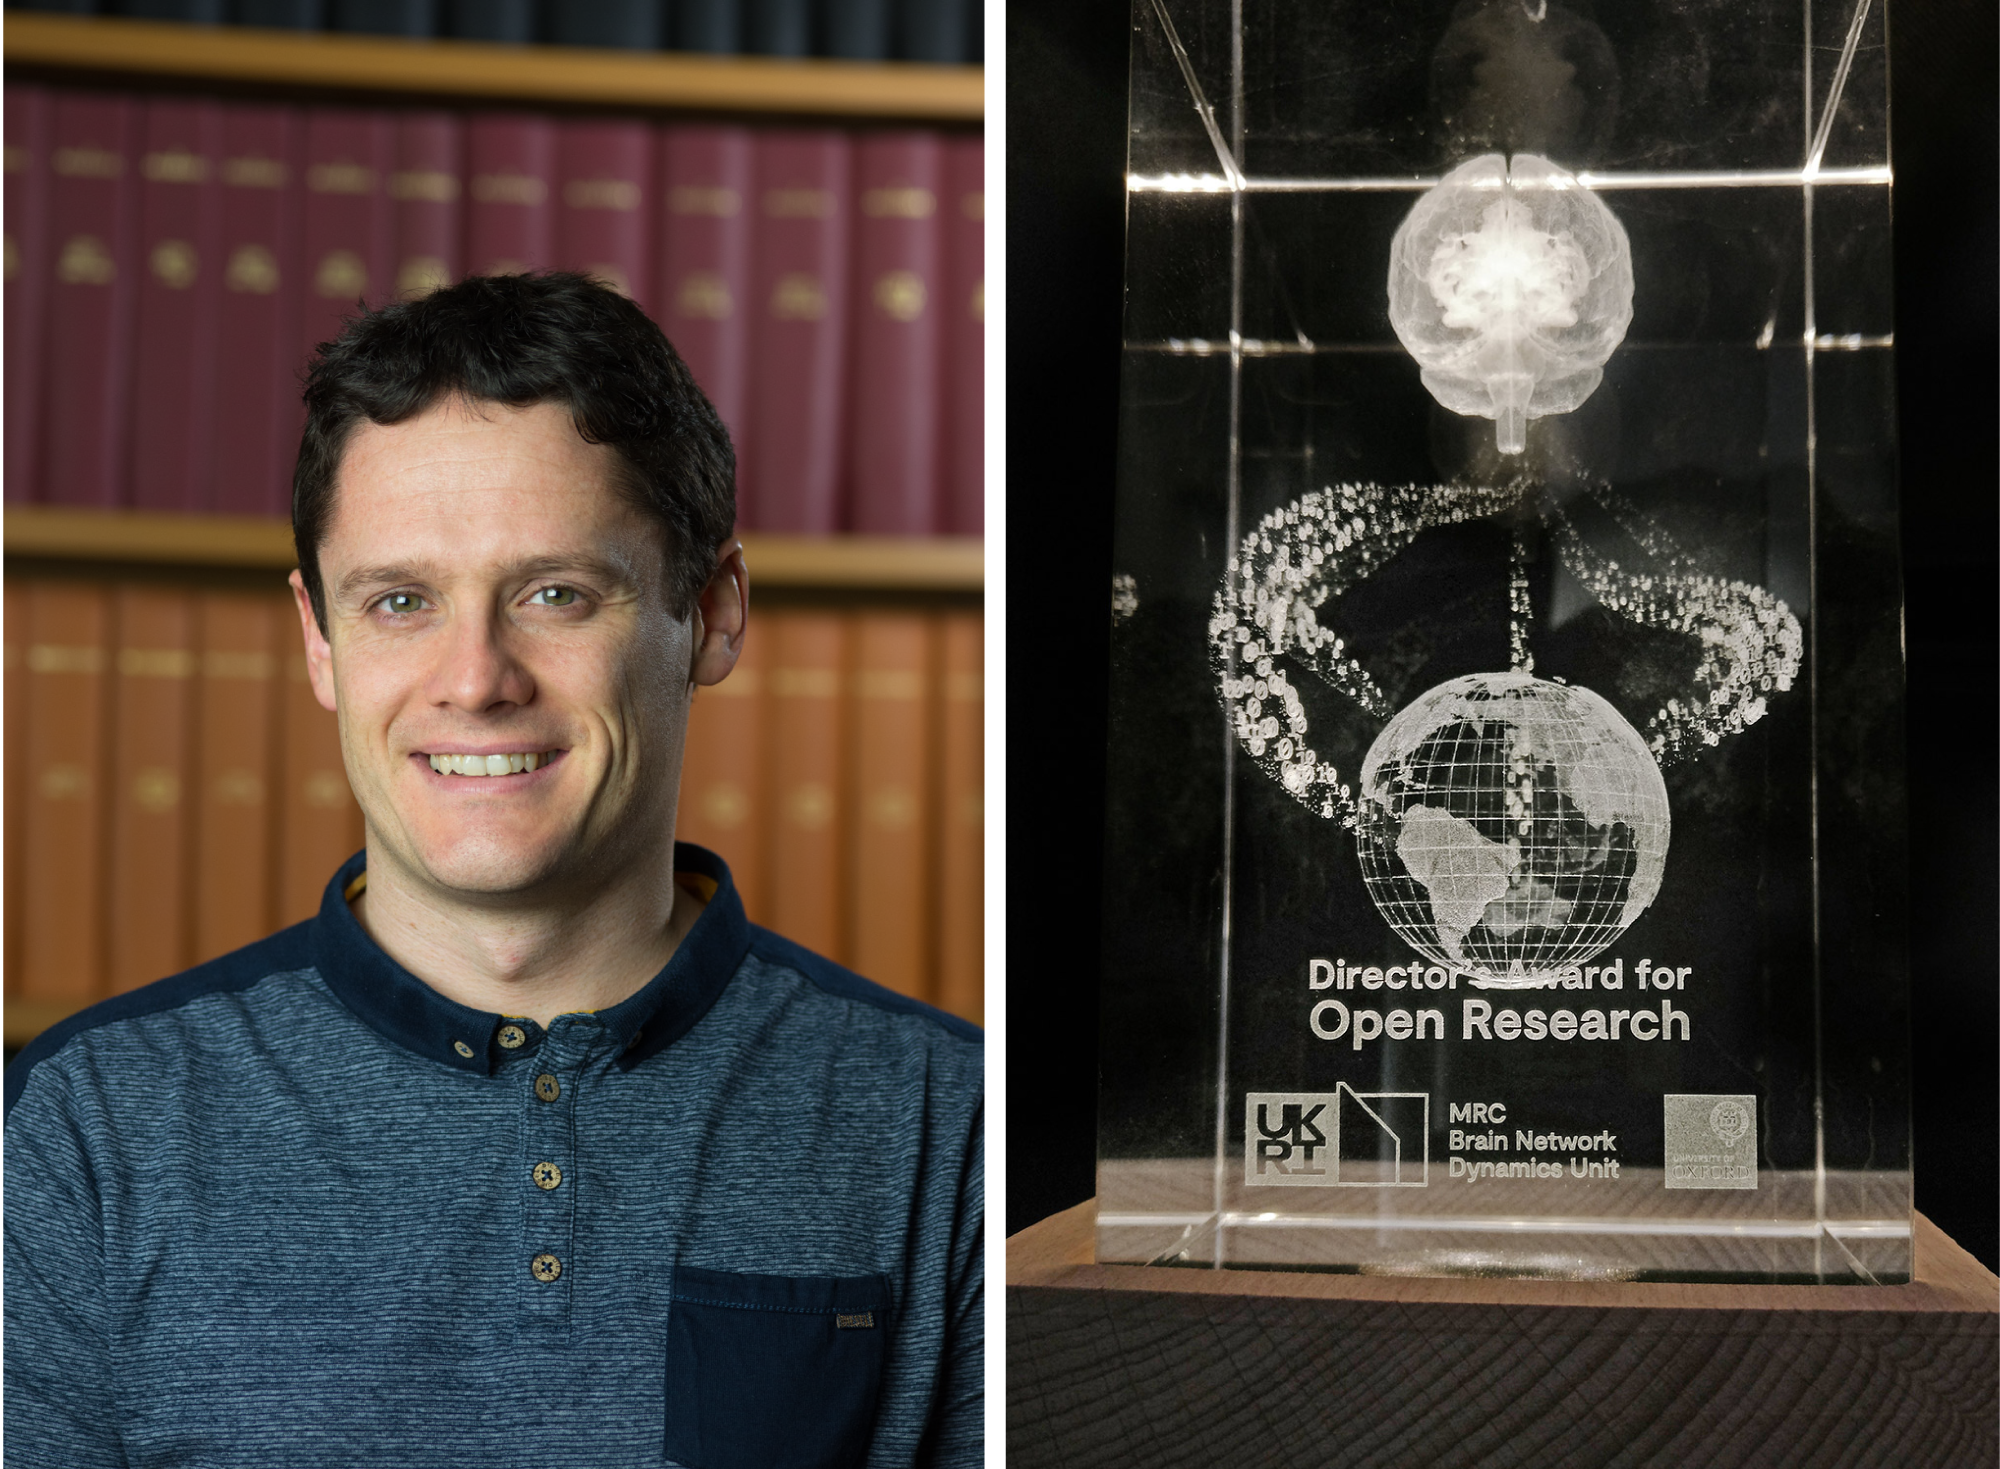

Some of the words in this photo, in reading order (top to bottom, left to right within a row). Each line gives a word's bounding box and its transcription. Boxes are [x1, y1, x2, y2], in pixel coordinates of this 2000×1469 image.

[1309, 959, 1491, 990] Director's
[1507, 958, 1624, 990] Award
[1635, 958, 1692, 990] for
[1310, 999, 1445, 1051] Open
[1462, 999, 1691, 1041] Research
[1449, 1102, 1507, 1124] MRC
[1449, 1130, 1509, 1151] Brain
[1516, 1130, 1617, 1152] Network
[1449, 1157, 1562, 1183] Dynamics
[1570, 1157, 1620, 1179] Unit
[1672, 1165, 1750, 1179] OXFORD
